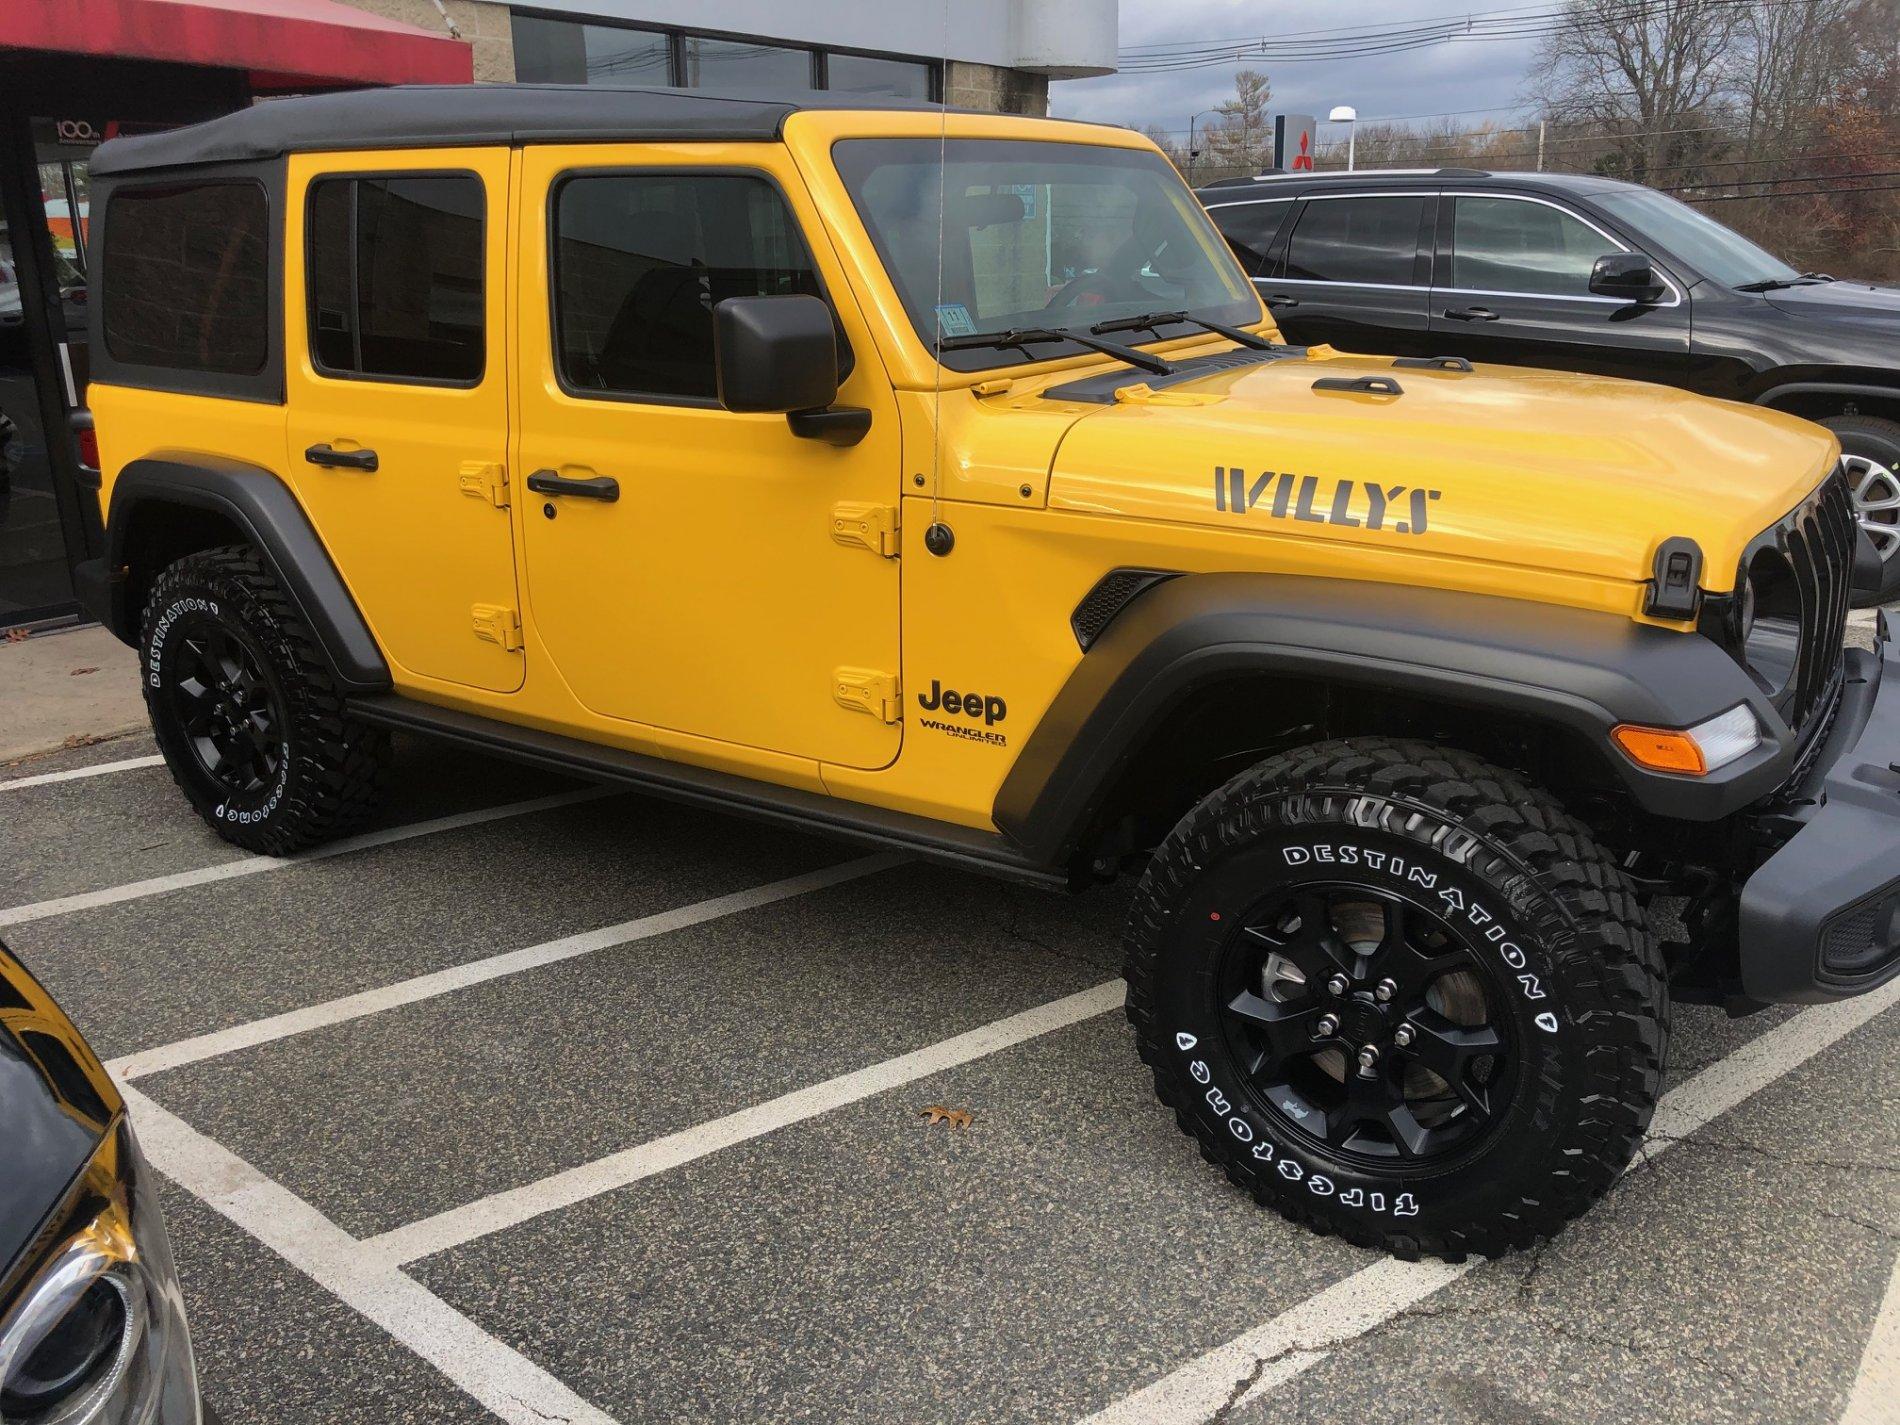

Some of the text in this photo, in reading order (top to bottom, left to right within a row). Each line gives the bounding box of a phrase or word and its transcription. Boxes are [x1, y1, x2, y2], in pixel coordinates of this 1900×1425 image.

[1215, 466, 1442, 535] WILLYS
[151, 597, 208, 688] DESTINATION
[918, 679, 1007, 726] Jeep
[920, 718, 1006, 743] WRANGLER
[947, 730, 1007, 747] UNLIMITED
[1282, 844, 1547, 1000] DESTINATION
